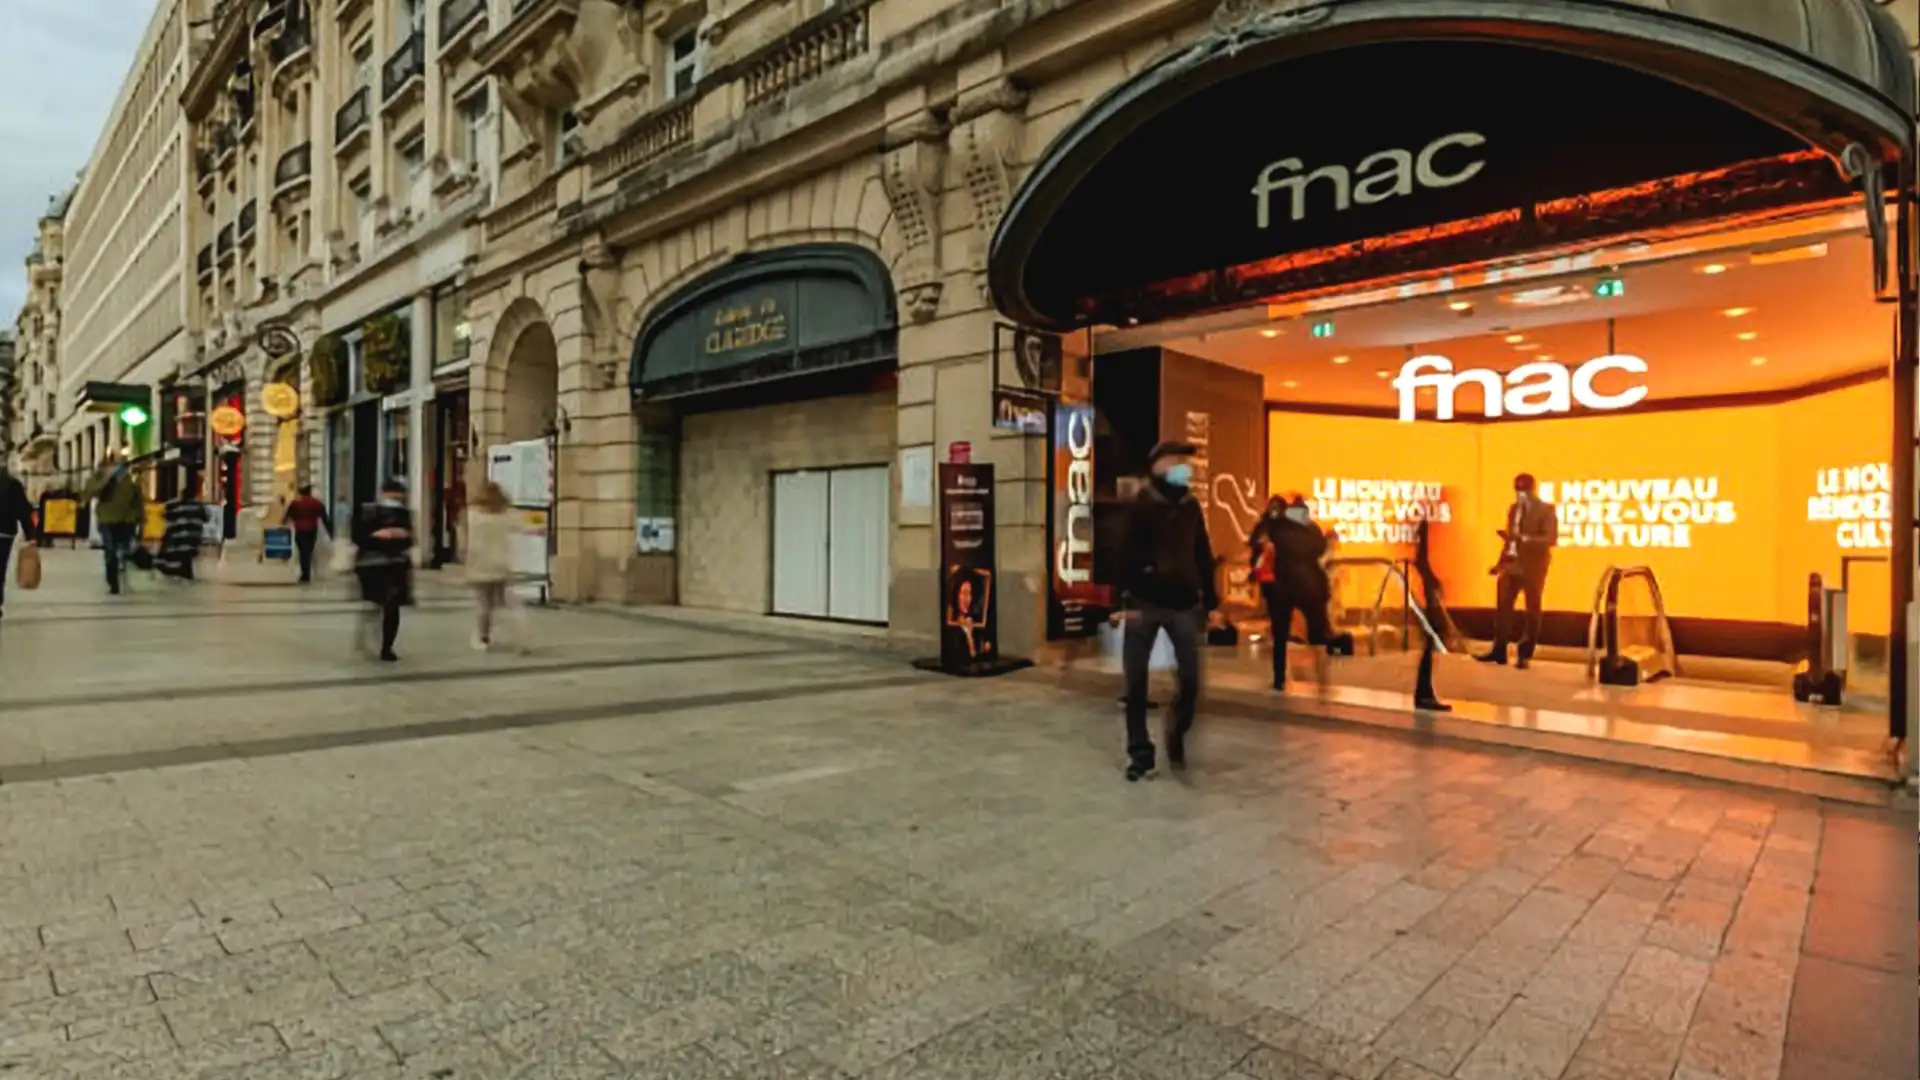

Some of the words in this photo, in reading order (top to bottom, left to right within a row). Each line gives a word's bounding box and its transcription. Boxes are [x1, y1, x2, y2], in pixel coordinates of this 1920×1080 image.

[1251, 132, 1486, 228] fnac
[1392, 354, 1649, 423] fnac
[1057, 411, 1091, 588] fnac
[1340, 479, 1441, 501] NOUVEAU
[1561, 477, 1719, 501] NOUVEAU
[1334, 522, 1421, 543] CULTUR
